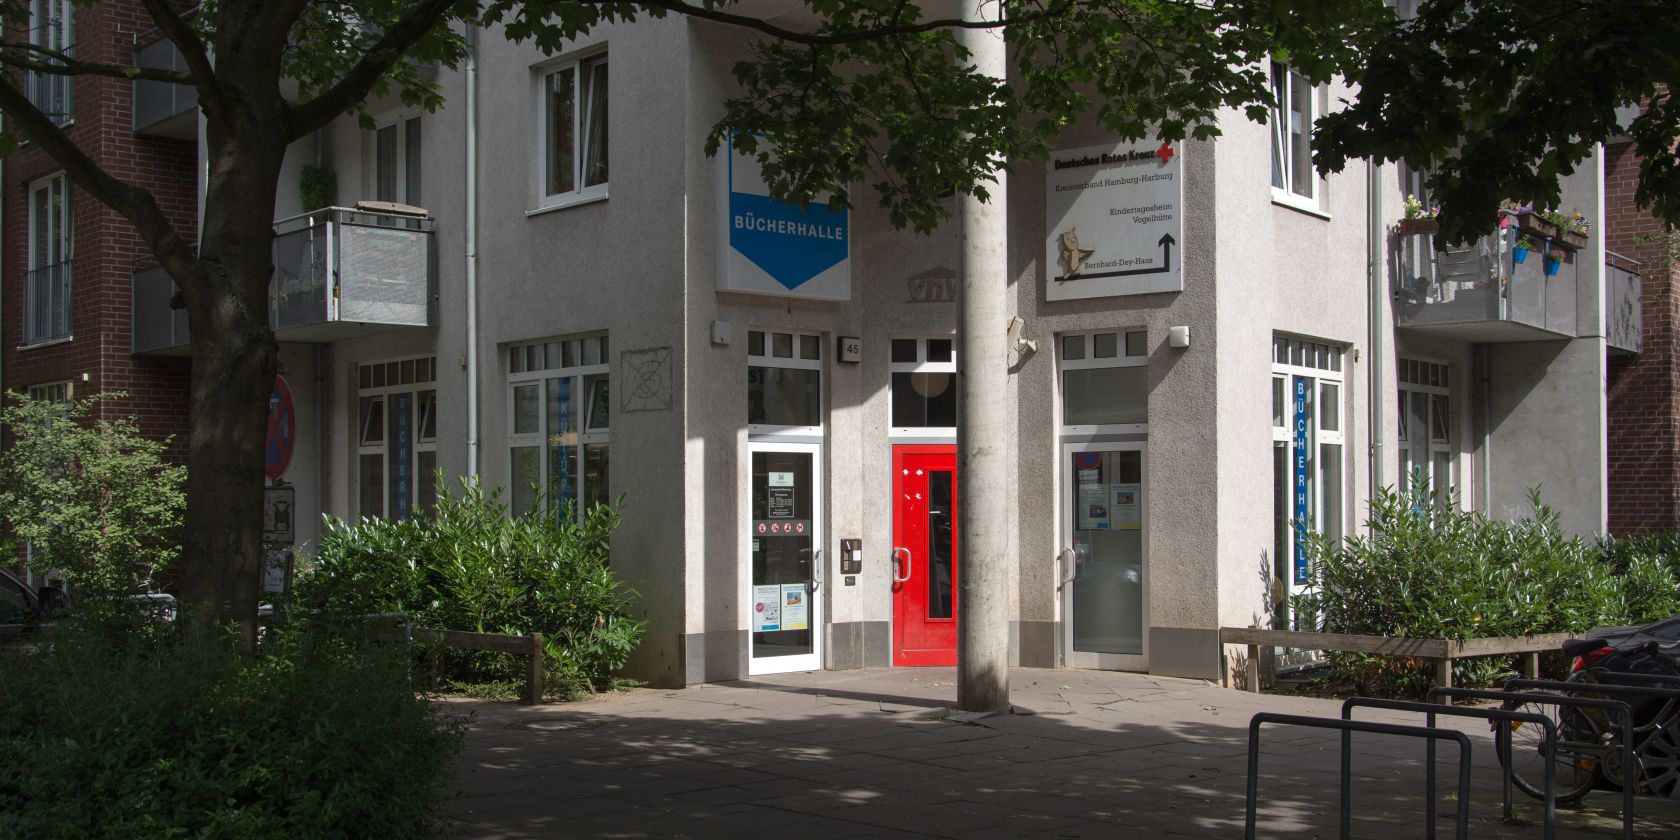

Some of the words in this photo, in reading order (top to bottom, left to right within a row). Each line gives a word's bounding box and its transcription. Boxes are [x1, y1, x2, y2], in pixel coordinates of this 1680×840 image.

[1054, 156, 1099, 170] Deutsches
[1101, 152, 1127, 165] Rotes
[1129, 149, 1156, 161] Kreuz
[1055, 179, 1103, 193] Kreisverband
[1104, 172, 1173, 187] Hamburg-Harburg
[1109, 203, 1173, 216] Kindertagesheim
[735, 212, 843, 240] BÜCHERHALLE
[1132, 213, 1173, 225] Vogelhütte
[1084, 257, 1154, 270] Bernhard-Dey-Haus
[846, 344, 859, 354] 45
[1297, 382, 1305, 580] BÜCHERHALLE
